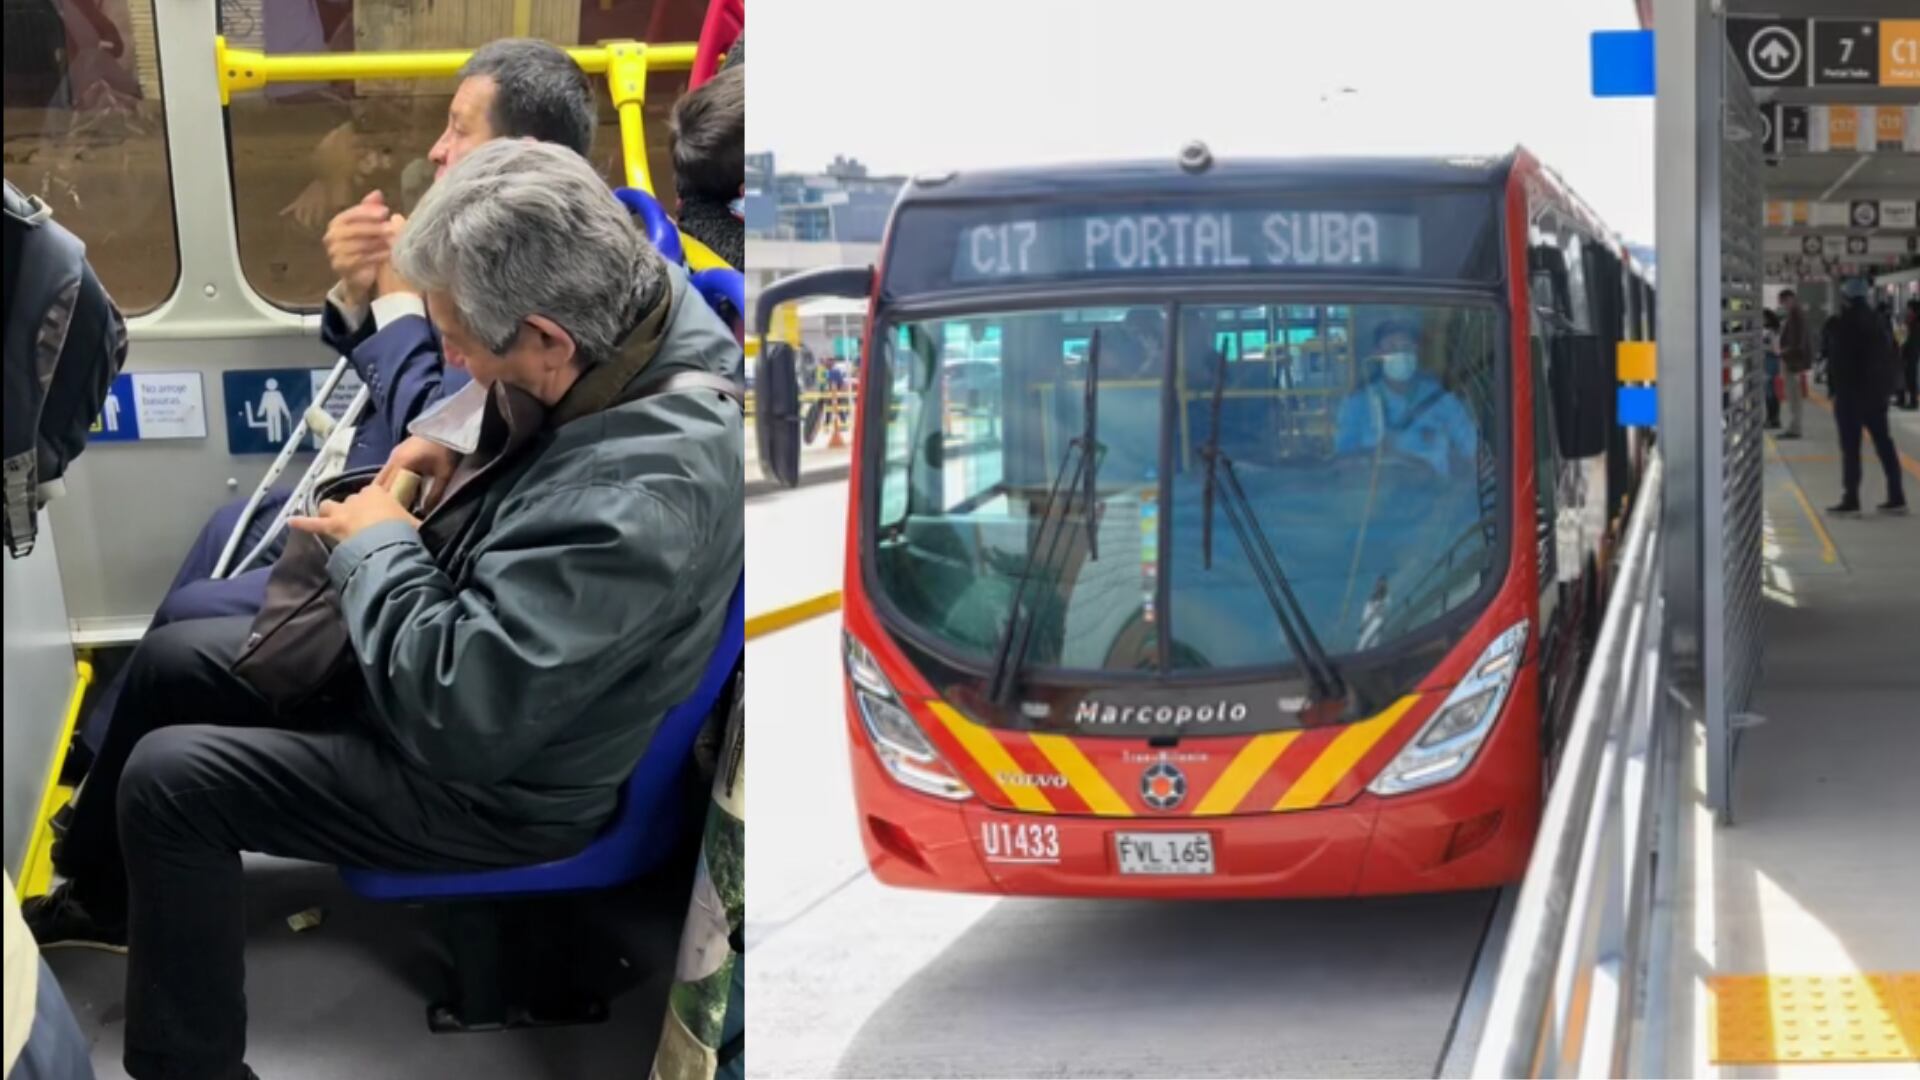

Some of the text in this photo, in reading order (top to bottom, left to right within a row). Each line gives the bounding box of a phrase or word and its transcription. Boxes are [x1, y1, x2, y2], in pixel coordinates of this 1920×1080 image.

[1839, 37, 1855, 63] 7
[1891, 38, 1920, 64] C1
[969, 212, 1379, 273] C17 PORTAL SUBA
[141, 383, 156, 393] No
[1075, 700, 1247, 724] Marcopolo
[996, 771, 1068, 788] VOLVO
[981, 822, 1059, 857] U1433
[1119, 841, 1210, 863] FVL 165
